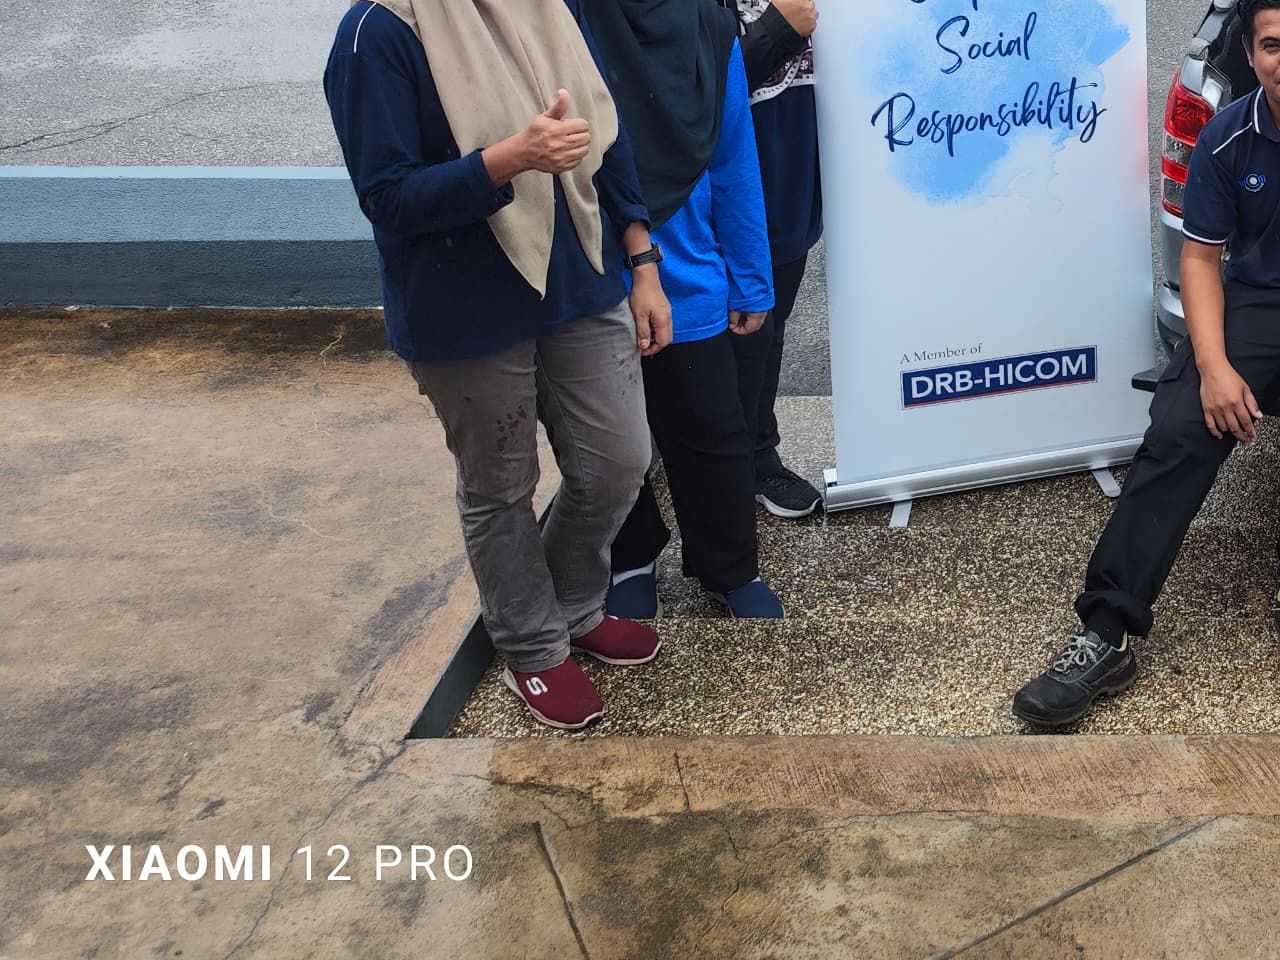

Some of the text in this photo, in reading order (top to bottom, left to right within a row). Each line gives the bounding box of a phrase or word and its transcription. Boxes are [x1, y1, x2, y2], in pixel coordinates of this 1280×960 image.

[935, 11, 1038, 74] Social
[870, 77, 1107, 157] Responsibility
[900, 342, 983, 365] A Member of
[910, 353, 1088, 399] DRB-HICOM
